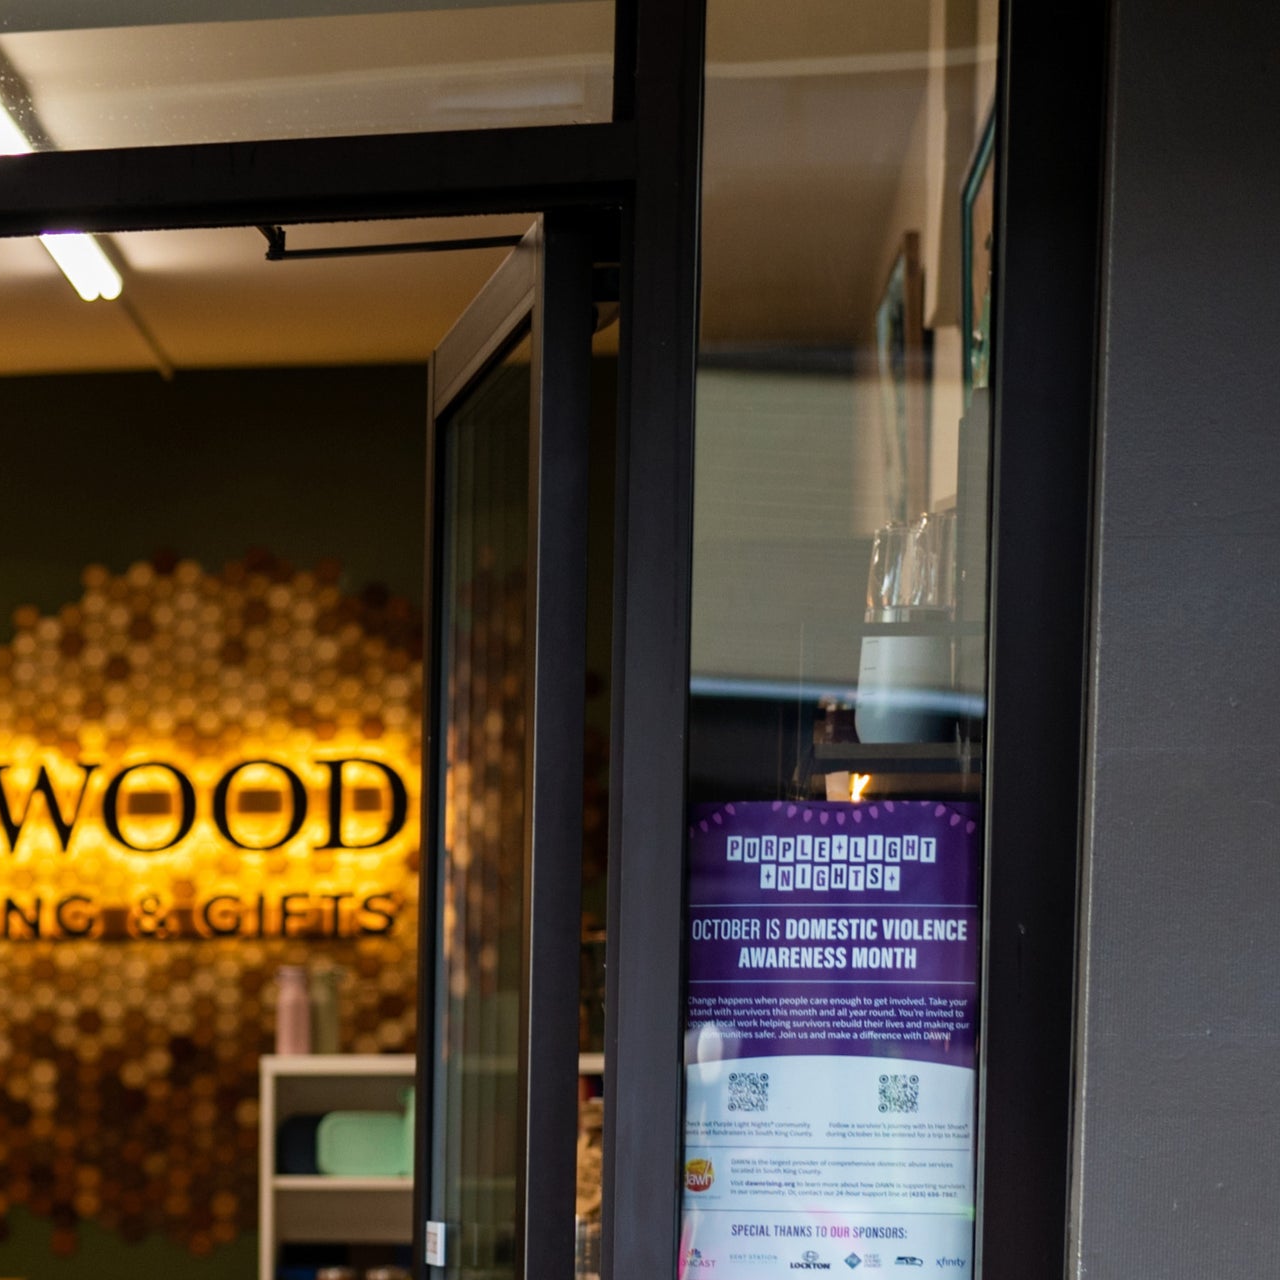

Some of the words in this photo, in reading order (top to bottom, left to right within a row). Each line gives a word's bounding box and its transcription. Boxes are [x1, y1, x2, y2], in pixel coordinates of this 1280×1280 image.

[729, 838, 828, 860] PURPLE
[852, 838, 935, 860] LIGHT
[780, 867, 880, 888] NIGHTS
[137, 894, 169, 940] &
[203, 891, 397, 939] GIFTS
[692, 919, 760, 940] OCTOBER
[766, 919, 780, 940] IS
[785, 919, 878, 941] DOMESTIC
[882, 919, 967, 941] VIOLENCE
[738, 947, 847, 968] AWARENESS
[851, 948, 917, 969] MONTH
[718, 996, 753, 1005] happens
[754, 997, 778, 1005] when
[778, 997, 808, 1006] people
[830, 998, 861, 1006] enough
[889, 998, 927, 1006] involved.
[689, 1008, 712, 1016] stand
[713, 1008, 731, 1016] with
[732, 1008, 771, 1016] survivors
[772, 1009, 788, 1017] this
[789, 1009, 817, 1017] month
[819, 1009, 835, 1017] and
[836, 1009, 848, 1017] all
[848, 1010, 867, 1018] year
[868, 1009, 897, 1017] round.
[898, 1010, 924, 1018] You're
[925, 1010, 954, 1018] invited
[955, 1010, 964, 1018] to
[688, 1020, 715, 1029] upport
[716, 1020, 736, 1028] local
[737, 1020, 759, 1028] work
[760, 1020, 791, 1030] helping
[792, 1021, 831, 1029] survivors
[832, 1021, 862, 1029] rebuild
[863, 1021, 884, 1029] their
[885, 1021, 904, 1029] lives
[906, 1021, 922, 1030] and
[923, 1021, 954, 1031] making
[754, 1031, 777, 1039] safer.
[778, 1031, 796, 1039] Join
[809, 1031, 826, 1039] and
[827, 1031, 851, 1040] make
[859, 1031, 902, 1040] difference
[903, 1032, 922, 1040] with
[731, 1224, 771, 1237] SPECIAL
[773, 1225, 812, 1238] THANKS
[815, 1226, 827, 1239] TO
[830, 1226, 850, 1239] OUR
[852, 1227, 908, 1240] SPONSORS:
[789, 1262, 831, 1270] LOCKTON
[935, 1257, 966, 1269] xfinity
